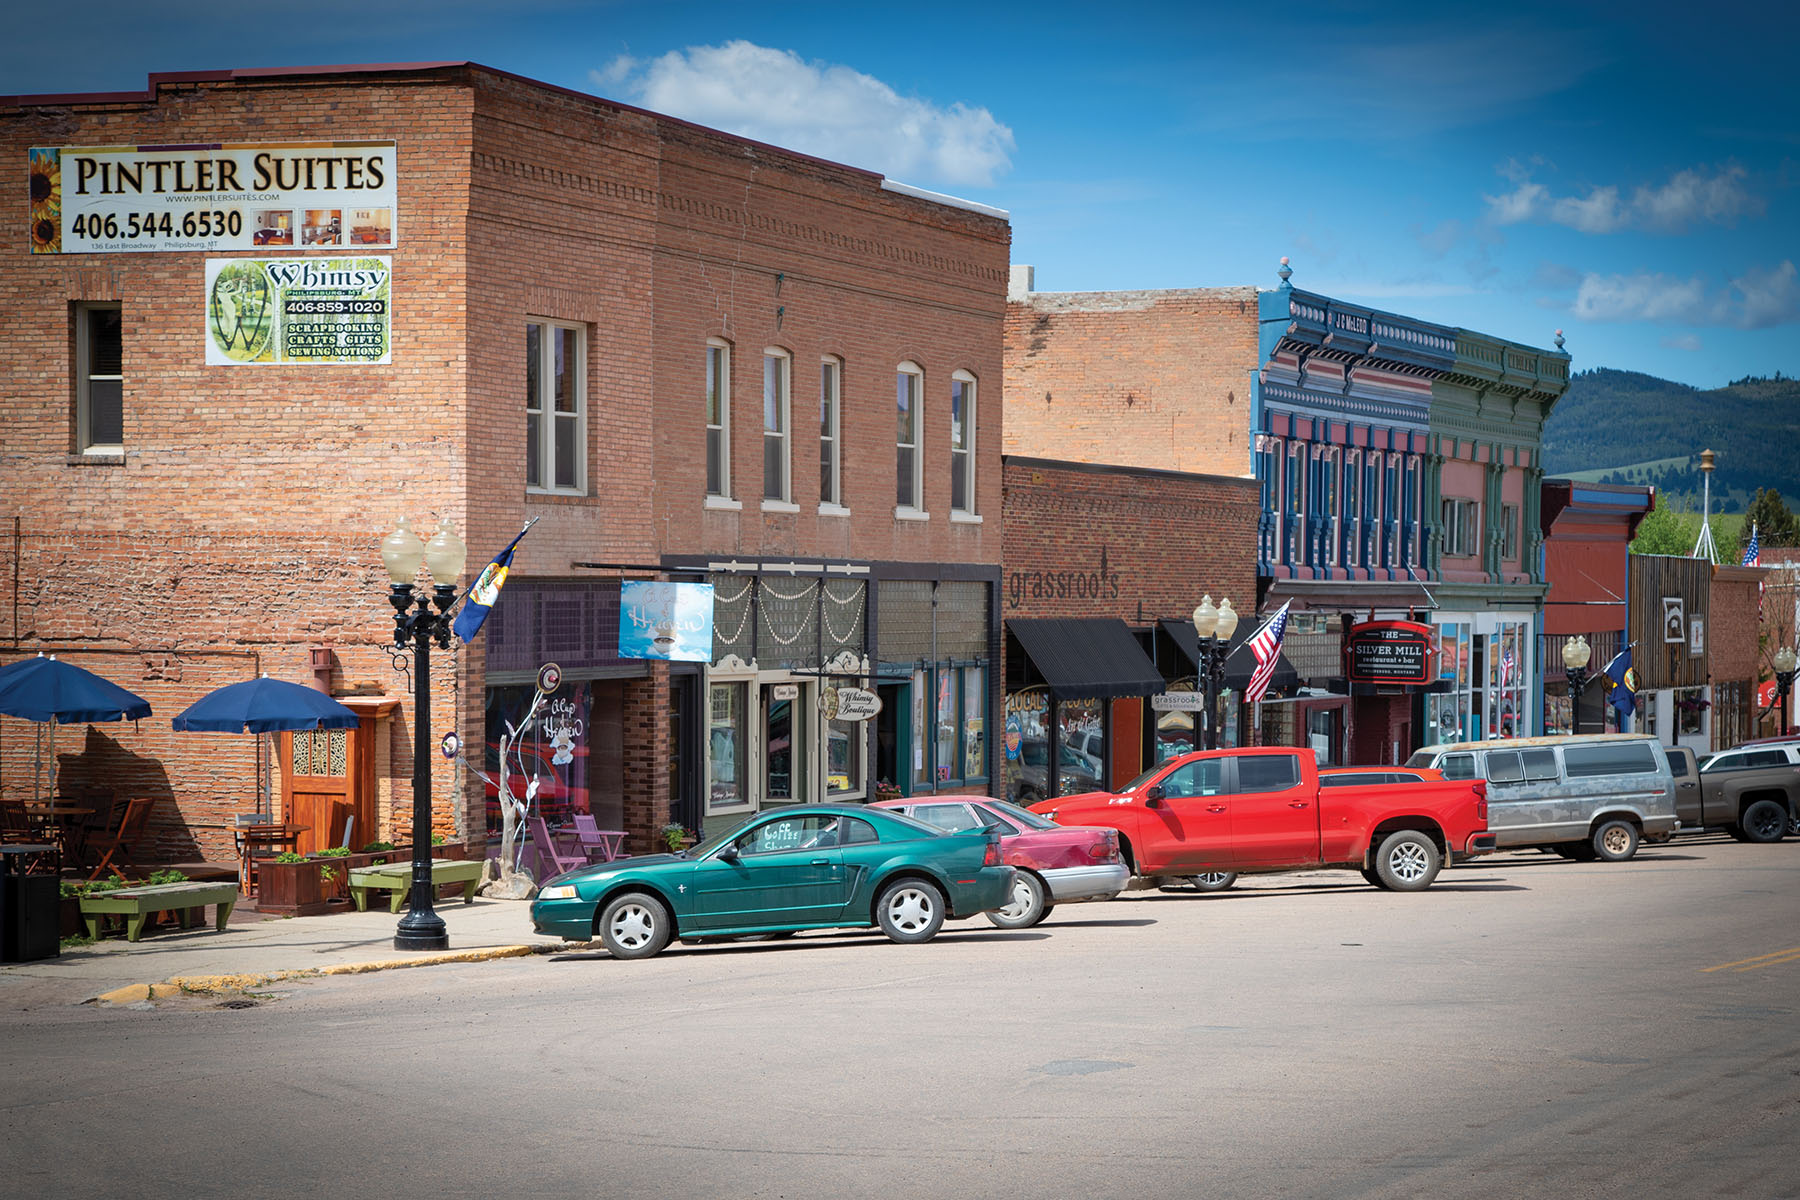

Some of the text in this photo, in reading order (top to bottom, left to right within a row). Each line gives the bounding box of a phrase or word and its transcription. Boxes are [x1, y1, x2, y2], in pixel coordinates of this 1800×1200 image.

[75, 153, 384, 194] PINTLER SUITES
[165, 193, 280, 203] WWW.PINTLERSUITES.COM
[72, 210, 241, 239] 406.544.6530
[105, 242, 120, 250] East
[121, 242, 157, 250] Broadway
[267, 263, 385, 290] Whimsy
[286, 302, 383, 313] 406-859-1020
[288, 323, 382, 333] SCRAPBOOKING
[288, 335, 382, 345] CRAFTS GIFTS
[288, 347, 382, 356] SEWING NOTIONS
[1010, 558, 1119, 608] grassroots
[627, 605, 705, 633] Heaven
[1356, 645, 1422, 656] SILVER MILL
[840, 691, 874, 704] Whimsy
[1009, 692, 1042, 712] LOCAL
[840, 702, 875, 717] Boutique
[764, 823, 798, 840] Coffee
